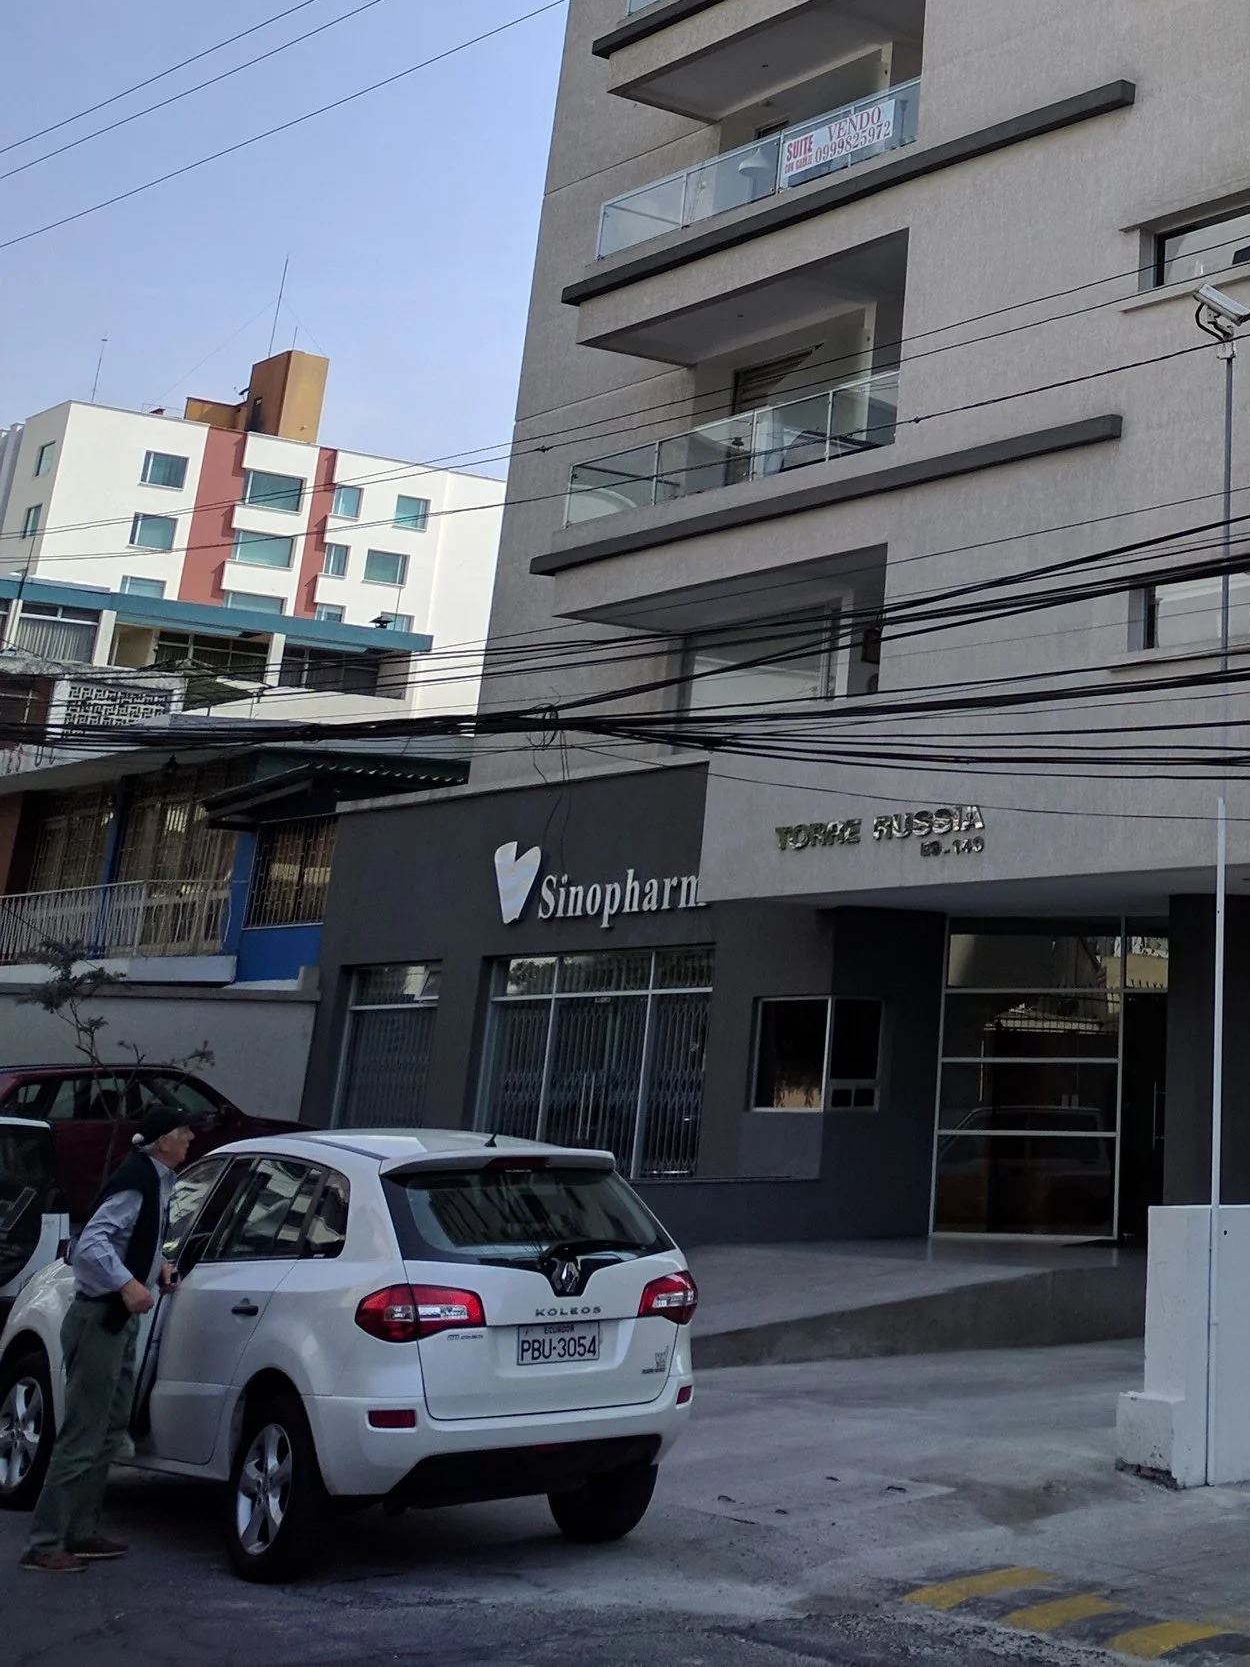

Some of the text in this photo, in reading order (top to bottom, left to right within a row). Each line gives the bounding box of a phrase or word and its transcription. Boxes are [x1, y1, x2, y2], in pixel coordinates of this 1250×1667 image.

[827, 106, 882, 142] VENDO
[786, 134, 814, 162] SUITE
[815, 120, 891, 163] 0999825972
[774, 805, 986, 851] TORRE RUSSIA
[537, 868, 708, 928] Sinopharm
[534, 1306, 602, 1317] KOLEOS
[543, 1324, 576, 1335] ECUADOR
[520, 1335, 598, 1362] PBU-3054
